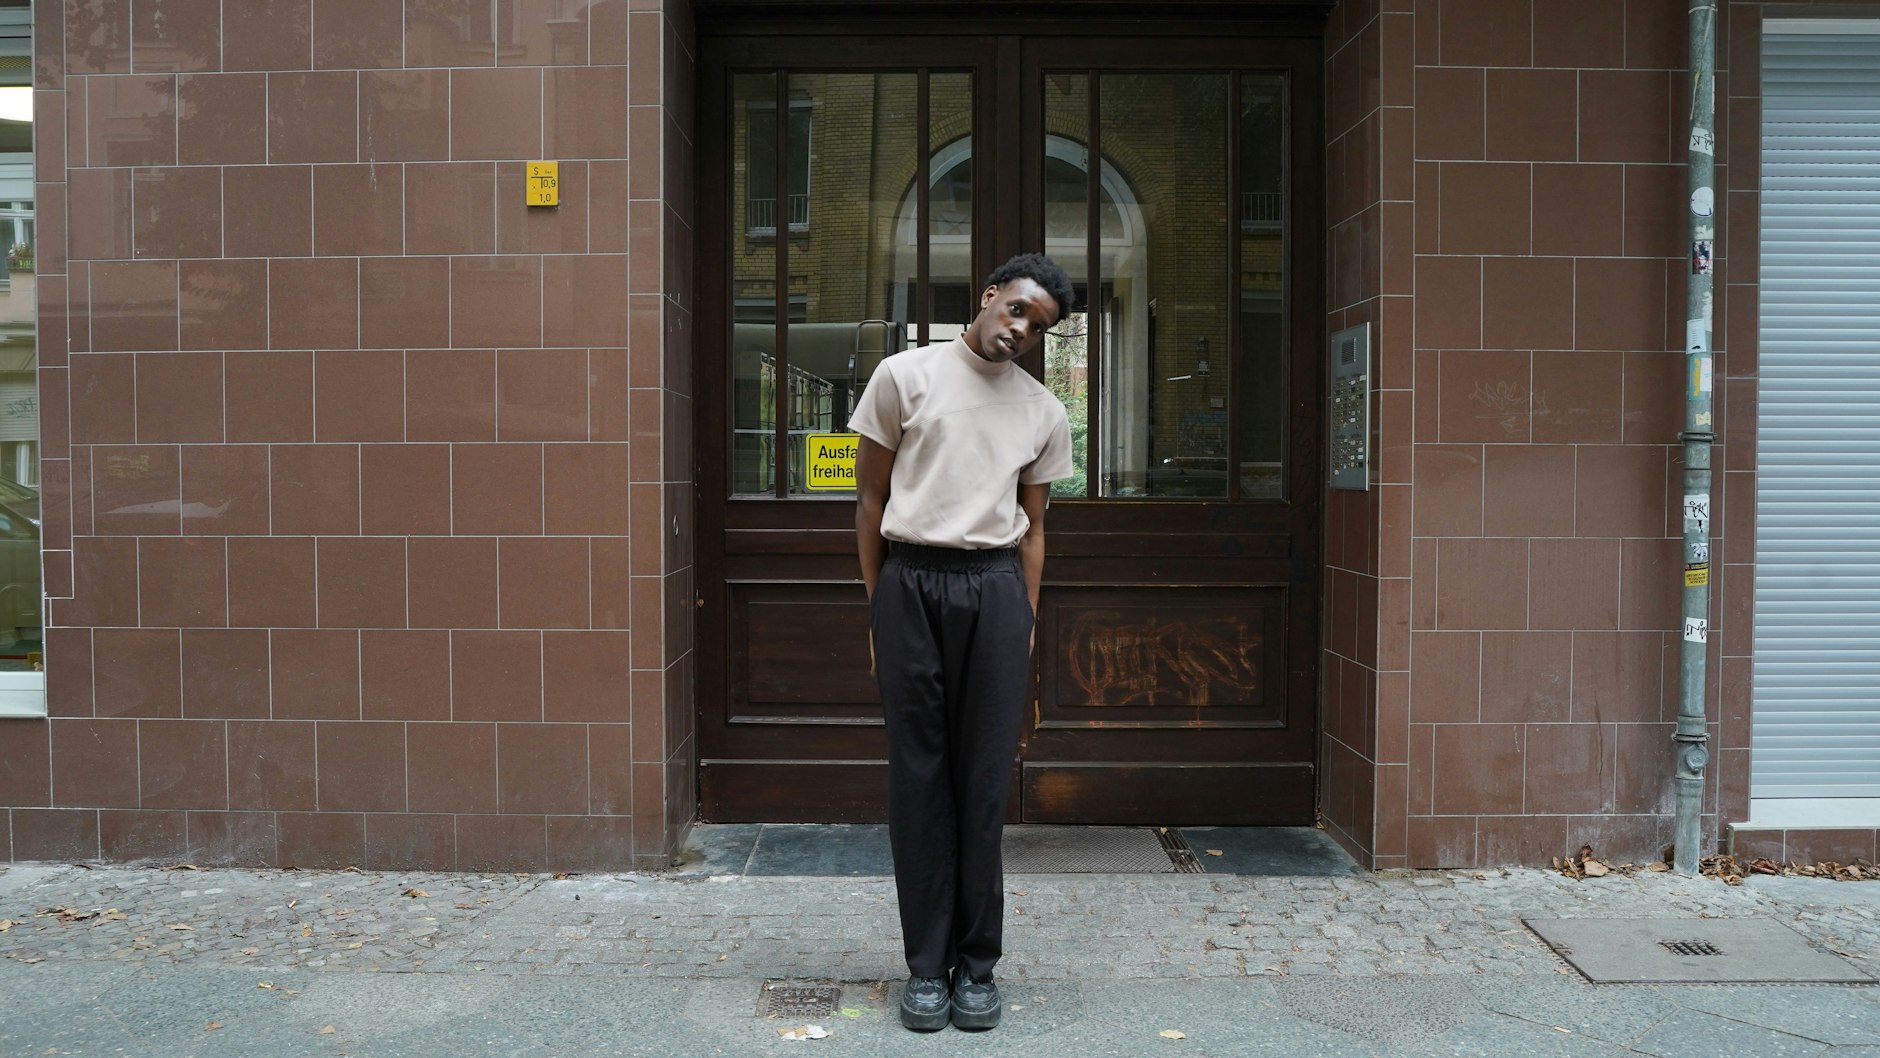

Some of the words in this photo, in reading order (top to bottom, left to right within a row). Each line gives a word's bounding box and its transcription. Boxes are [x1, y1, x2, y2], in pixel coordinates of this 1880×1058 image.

[533, 166, 539, 176] S
[540, 193, 551, 203] 1,0
[818, 445, 858, 459] Ausfa
[813, 464, 857, 478] freihal
